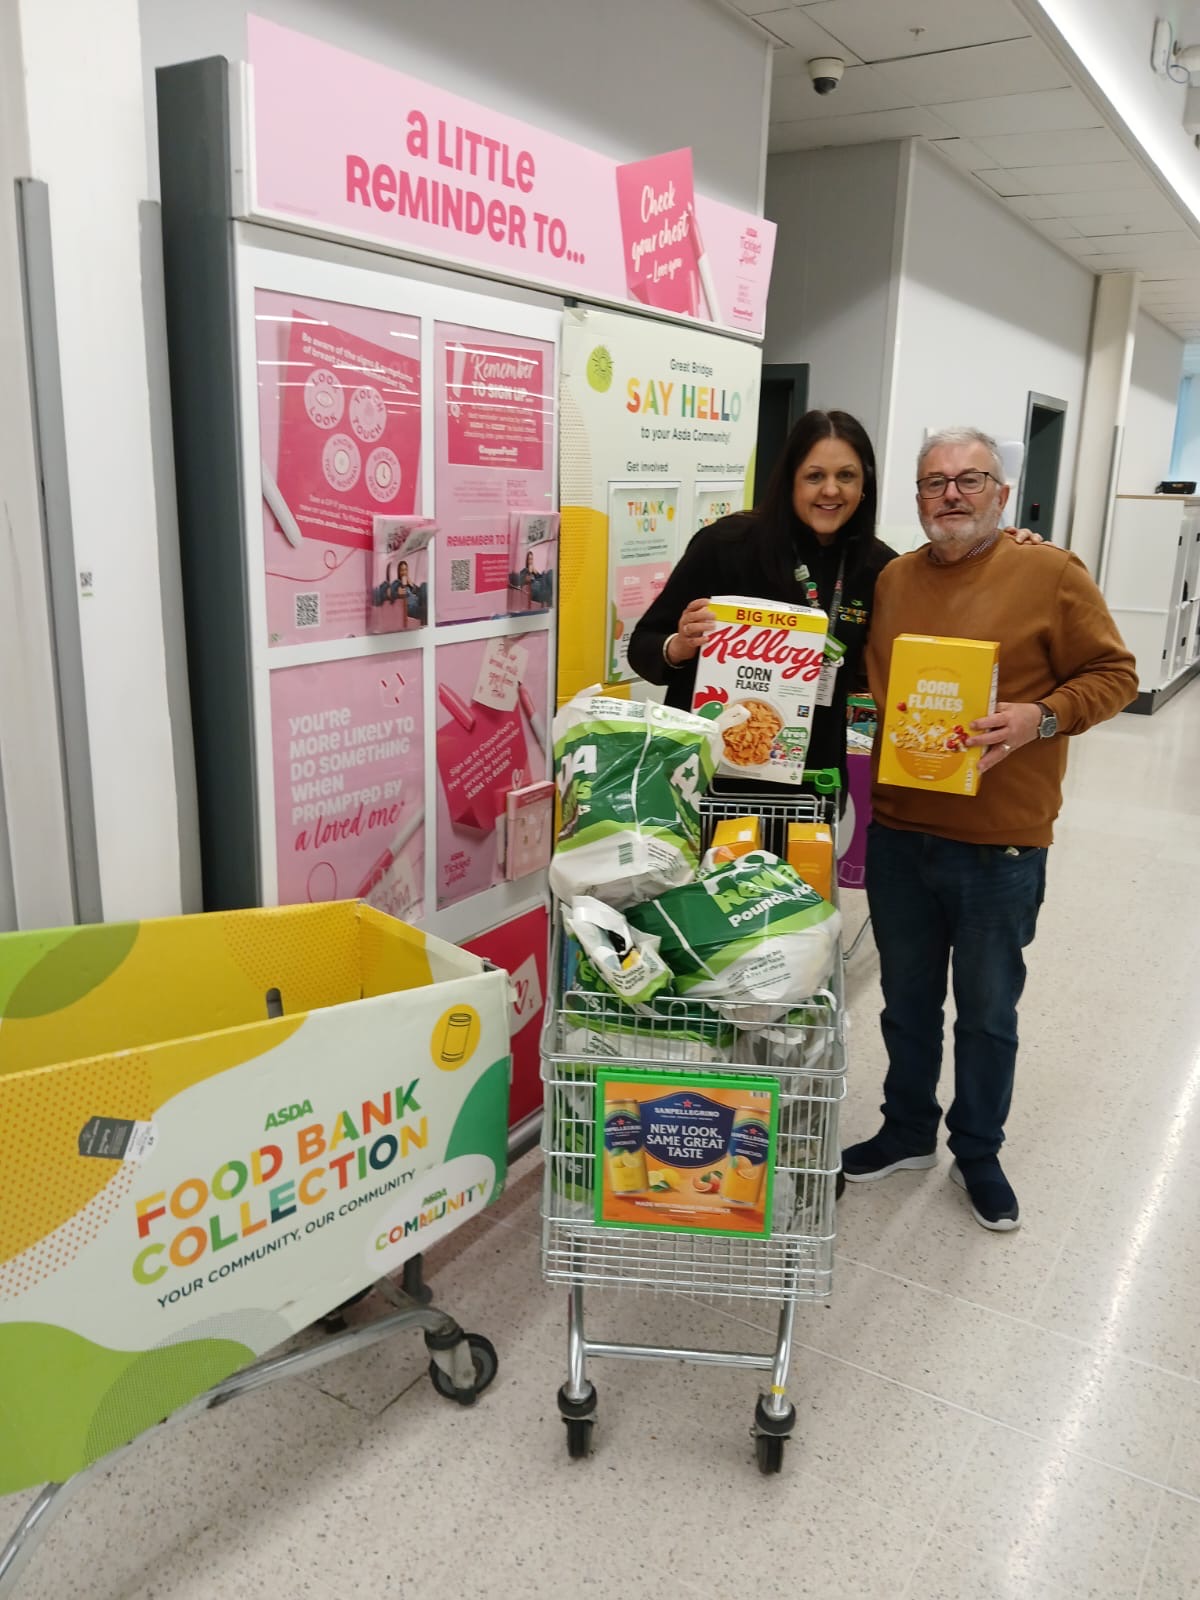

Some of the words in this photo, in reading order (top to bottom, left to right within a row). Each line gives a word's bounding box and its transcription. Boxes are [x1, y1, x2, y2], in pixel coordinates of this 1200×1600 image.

[641, 181, 675, 223] Check
[632, 235, 656, 272] your
[659, 211, 689, 249] chest
[670, 358, 690, 371] Great
[692, 362, 713, 377] Bridge
[626, 377, 674, 416] SAY
[681, 384, 741, 422] HELLO
[353, 416, 382, 440] TOUCH
[641, 427, 649, 439] to
[652, 428, 670, 441] your
[672, 429, 691, 441] Asda
[626, 461, 639, 472] Get
[641, 461, 669, 472] involved
[627, 501, 664, 516] THANK
[710, 503, 731, 515] FOOD
[637, 518, 656, 532] YOU
[736, 609, 762, 622] BIG
[768, 613, 798, 627] 1KG
[737, 665, 772, 682] CORN
[736, 679, 770, 693] FLAKES
[917, 679, 959, 697] CORN
[908, 694, 963, 713] FLAKES
[396, 716, 415, 733] TO
[290, 759, 317, 782] DO
[384, 779, 403, 798] BY
[295, 829, 307, 851] a
[314, 802, 364, 849] loved
[264, 1100, 314, 1131] ASDA
[654, 1107, 720, 1118] SANPELLEGRINO
[650, 1123, 679, 1134] NEW
[646, 1134, 681, 1146] SAME
[683, 1136, 725, 1149] GREAT
[135, 1144, 283, 1239] FOOD
[297, 1078, 422, 1165] BANK
[667, 1146, 704, 1159] TASTE
[132, 1116, 429, 1286] COLLECTION
[420, 1187, 448, 1207] ASDA
[375, 1178, 488, 1252] COMMUNITY
[156, 1277, 204, 1309] YOUR
[207, 1228, 302, 1284] COMMUNITY,
[304, 1210, 336, 1235] OUR
[338, 1169, 417, 1217] COMMUNITY
